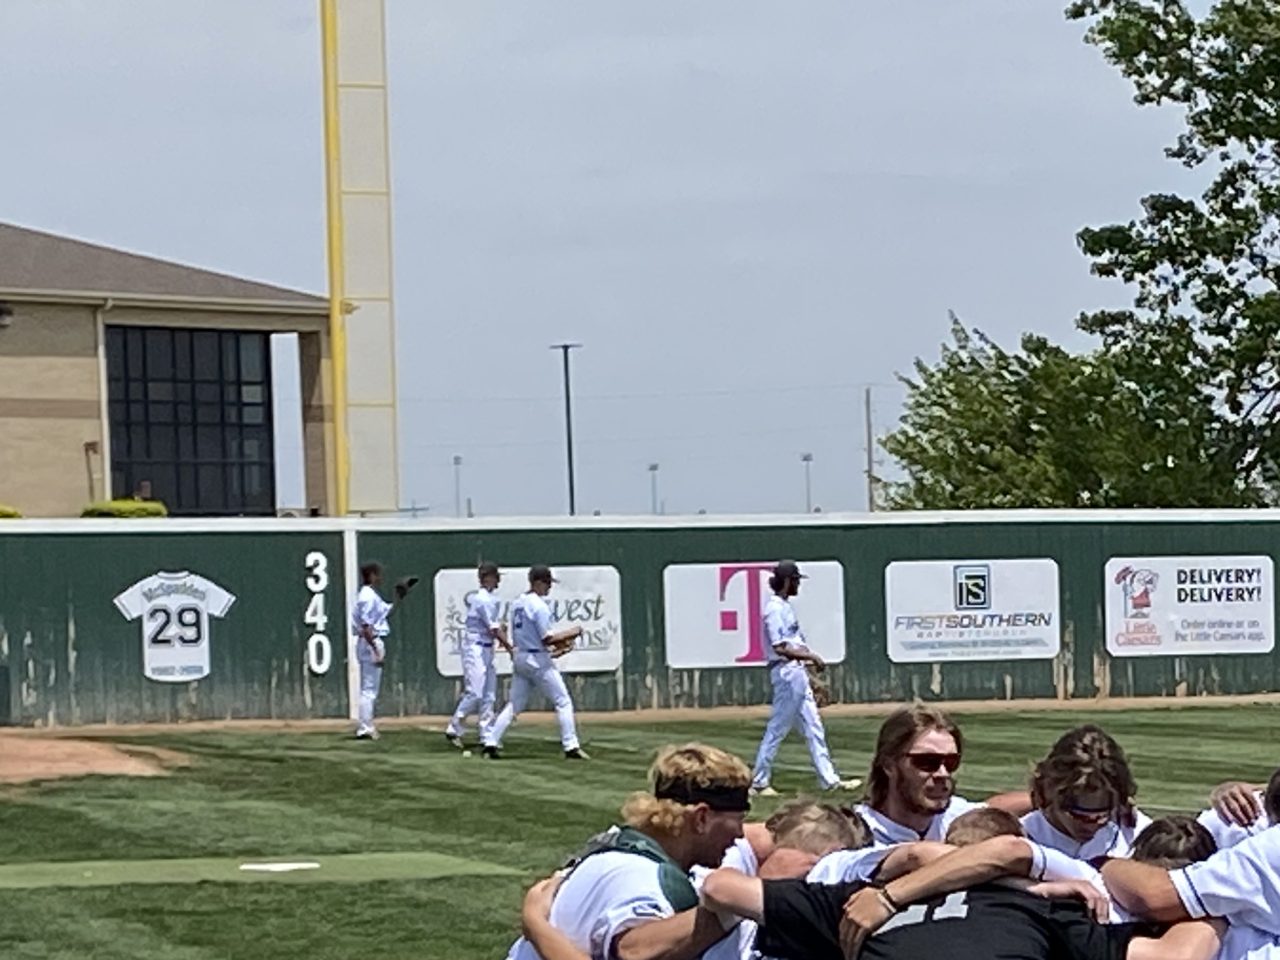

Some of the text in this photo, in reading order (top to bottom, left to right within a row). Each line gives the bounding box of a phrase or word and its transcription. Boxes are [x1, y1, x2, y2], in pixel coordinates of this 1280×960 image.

[1176, 568, 1262, 585] DELIVERY!
[1176, 586, 1262, 603] DELIVERY!
[149, 604, 205, 647] 29
[304, 551, 332, 674] 340
